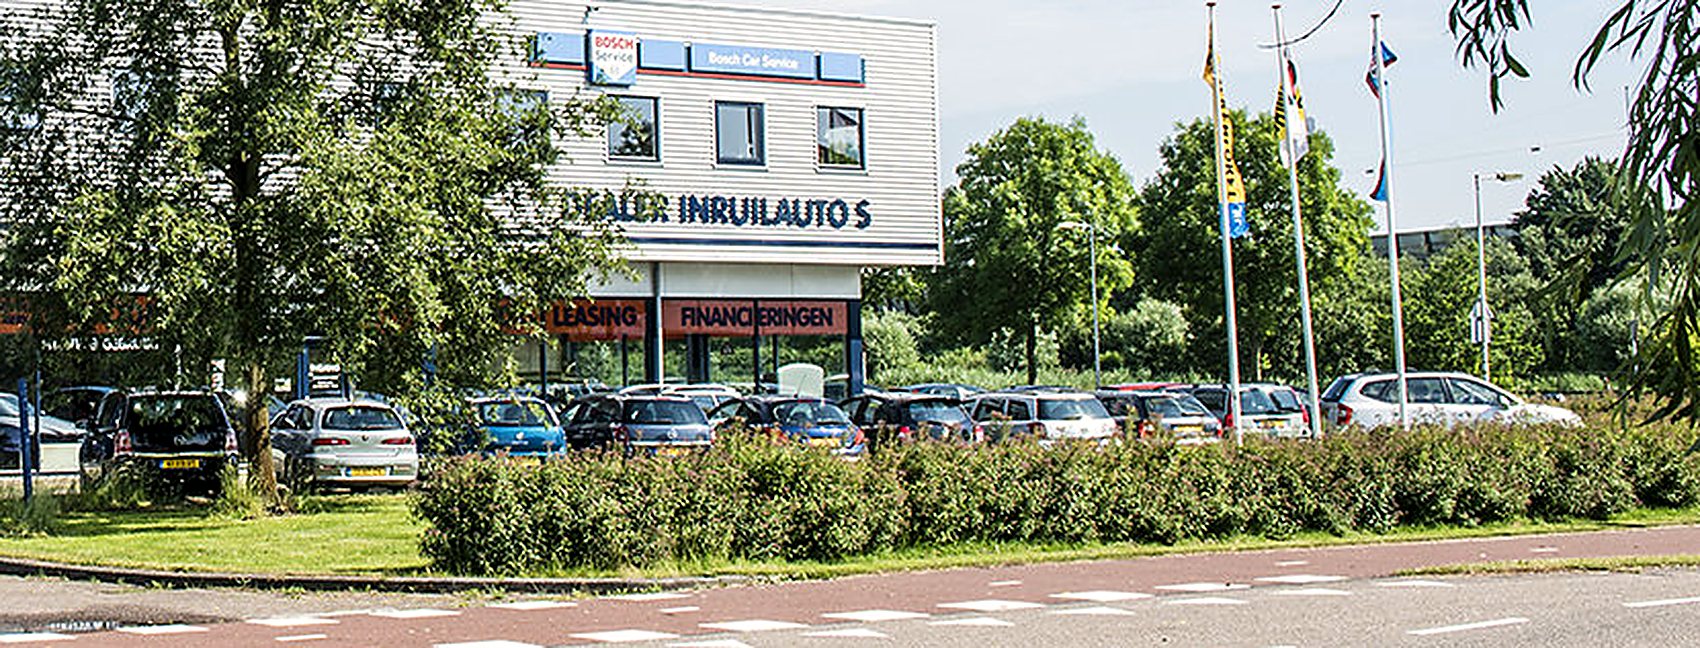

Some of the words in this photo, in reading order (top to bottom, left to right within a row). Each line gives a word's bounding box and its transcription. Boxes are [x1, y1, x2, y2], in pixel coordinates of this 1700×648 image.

[595, 36, 634, 50] BOSCH
[595, 49, 634, 63] Service
[708, 50, 740, 65] Bosch
[742, 53, 760, 66] Car
[761, 54, 799, 69] Service
[553, 306, 638, 327] LEASING
[681, 306, 834, 328] FINANCIERINGEN
